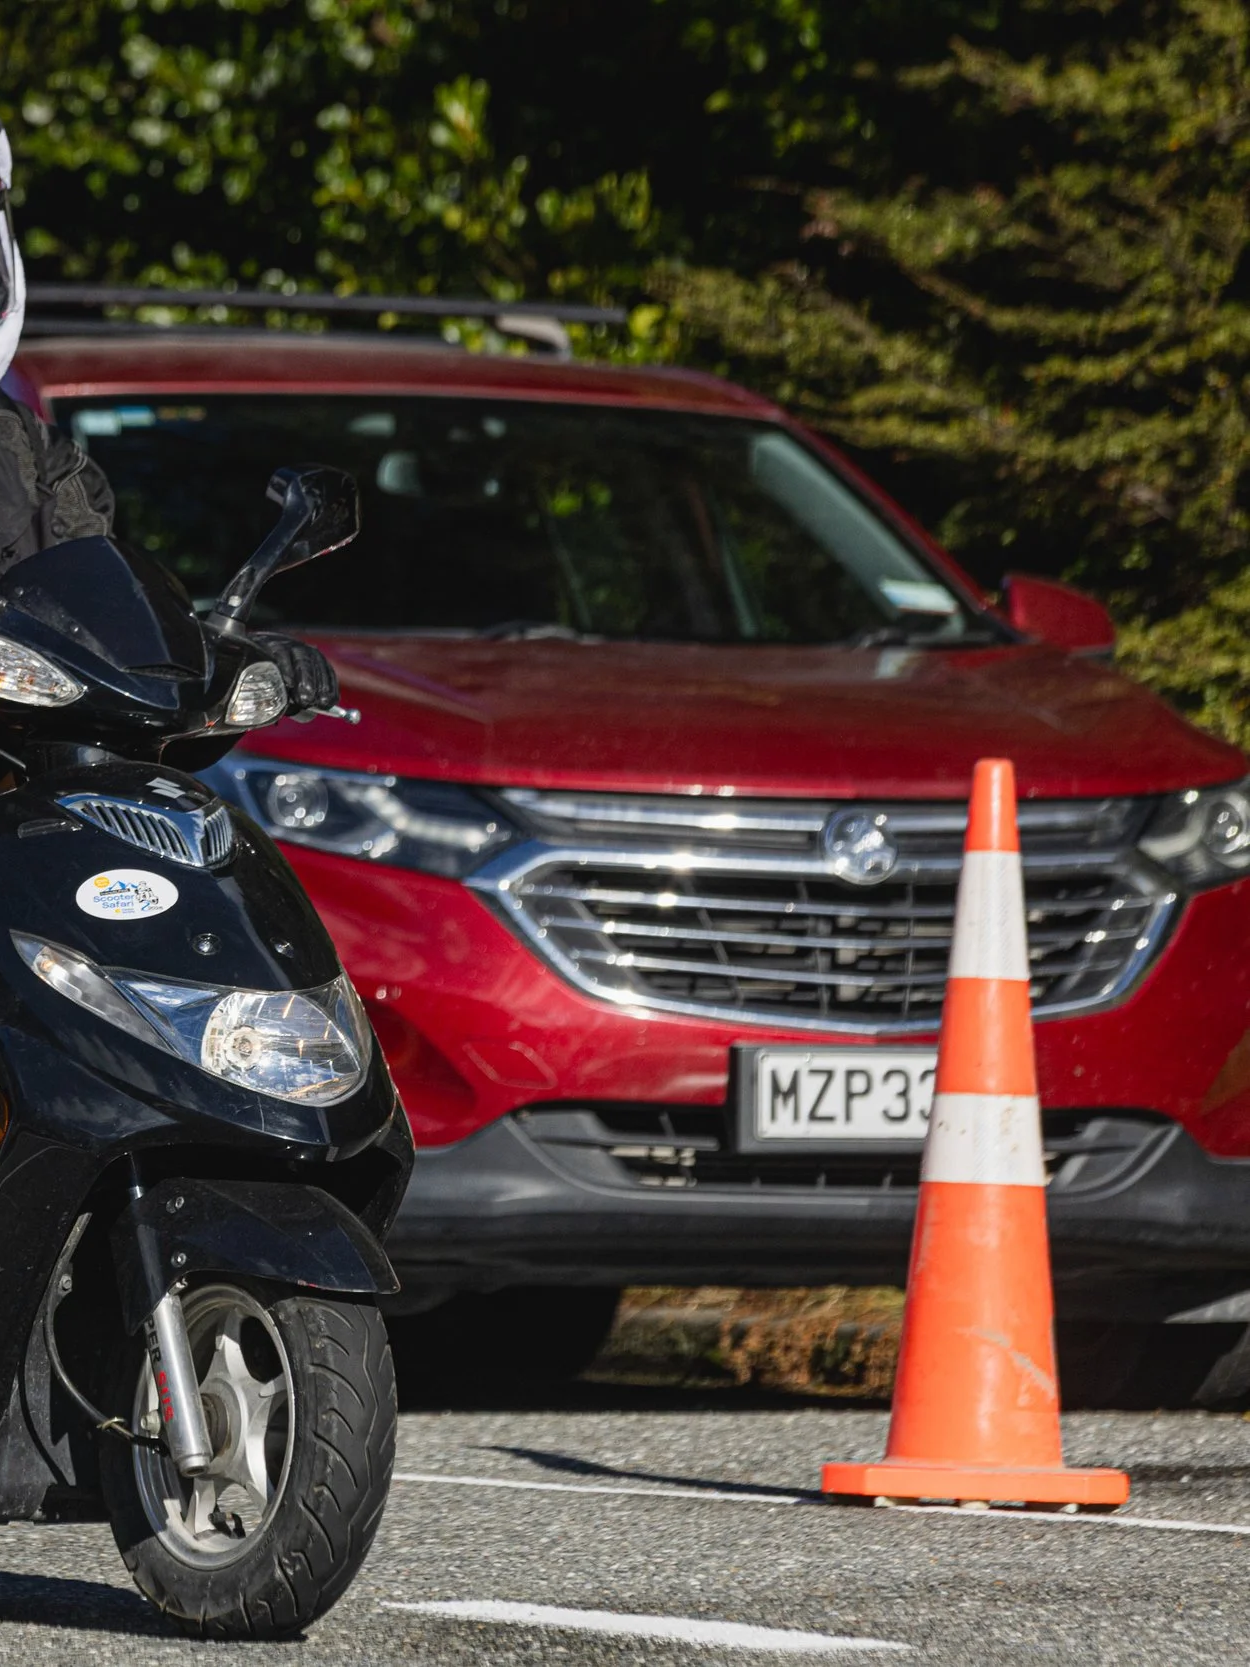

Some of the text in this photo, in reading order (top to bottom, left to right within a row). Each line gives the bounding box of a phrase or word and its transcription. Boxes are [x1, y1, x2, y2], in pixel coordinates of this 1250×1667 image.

[93, 893, 135, 903] Scooter
[102, 901, 134, 909] Safari
[158, 1370, 174, 1423] SUS
